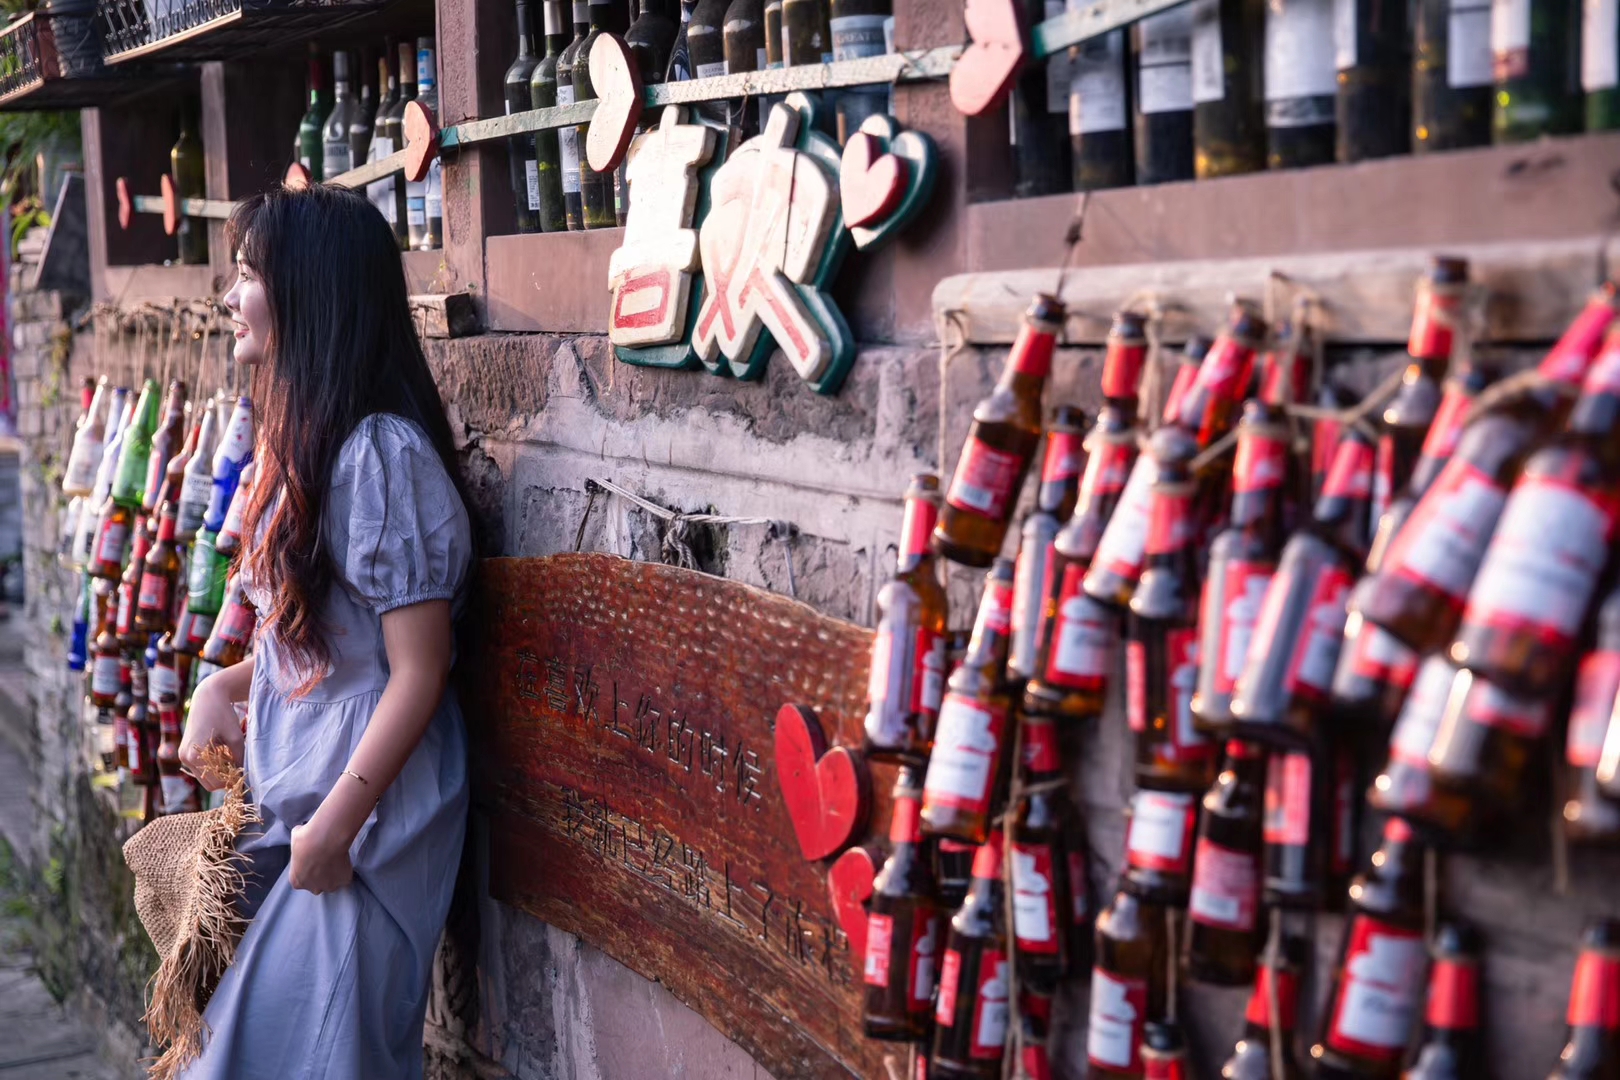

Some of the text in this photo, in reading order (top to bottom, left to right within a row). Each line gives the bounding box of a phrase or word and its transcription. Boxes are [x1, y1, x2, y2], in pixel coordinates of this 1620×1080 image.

[608, 96, 852, 390] 喜欢
[516, 647, 763, 812] 在喜欢上你的时候
